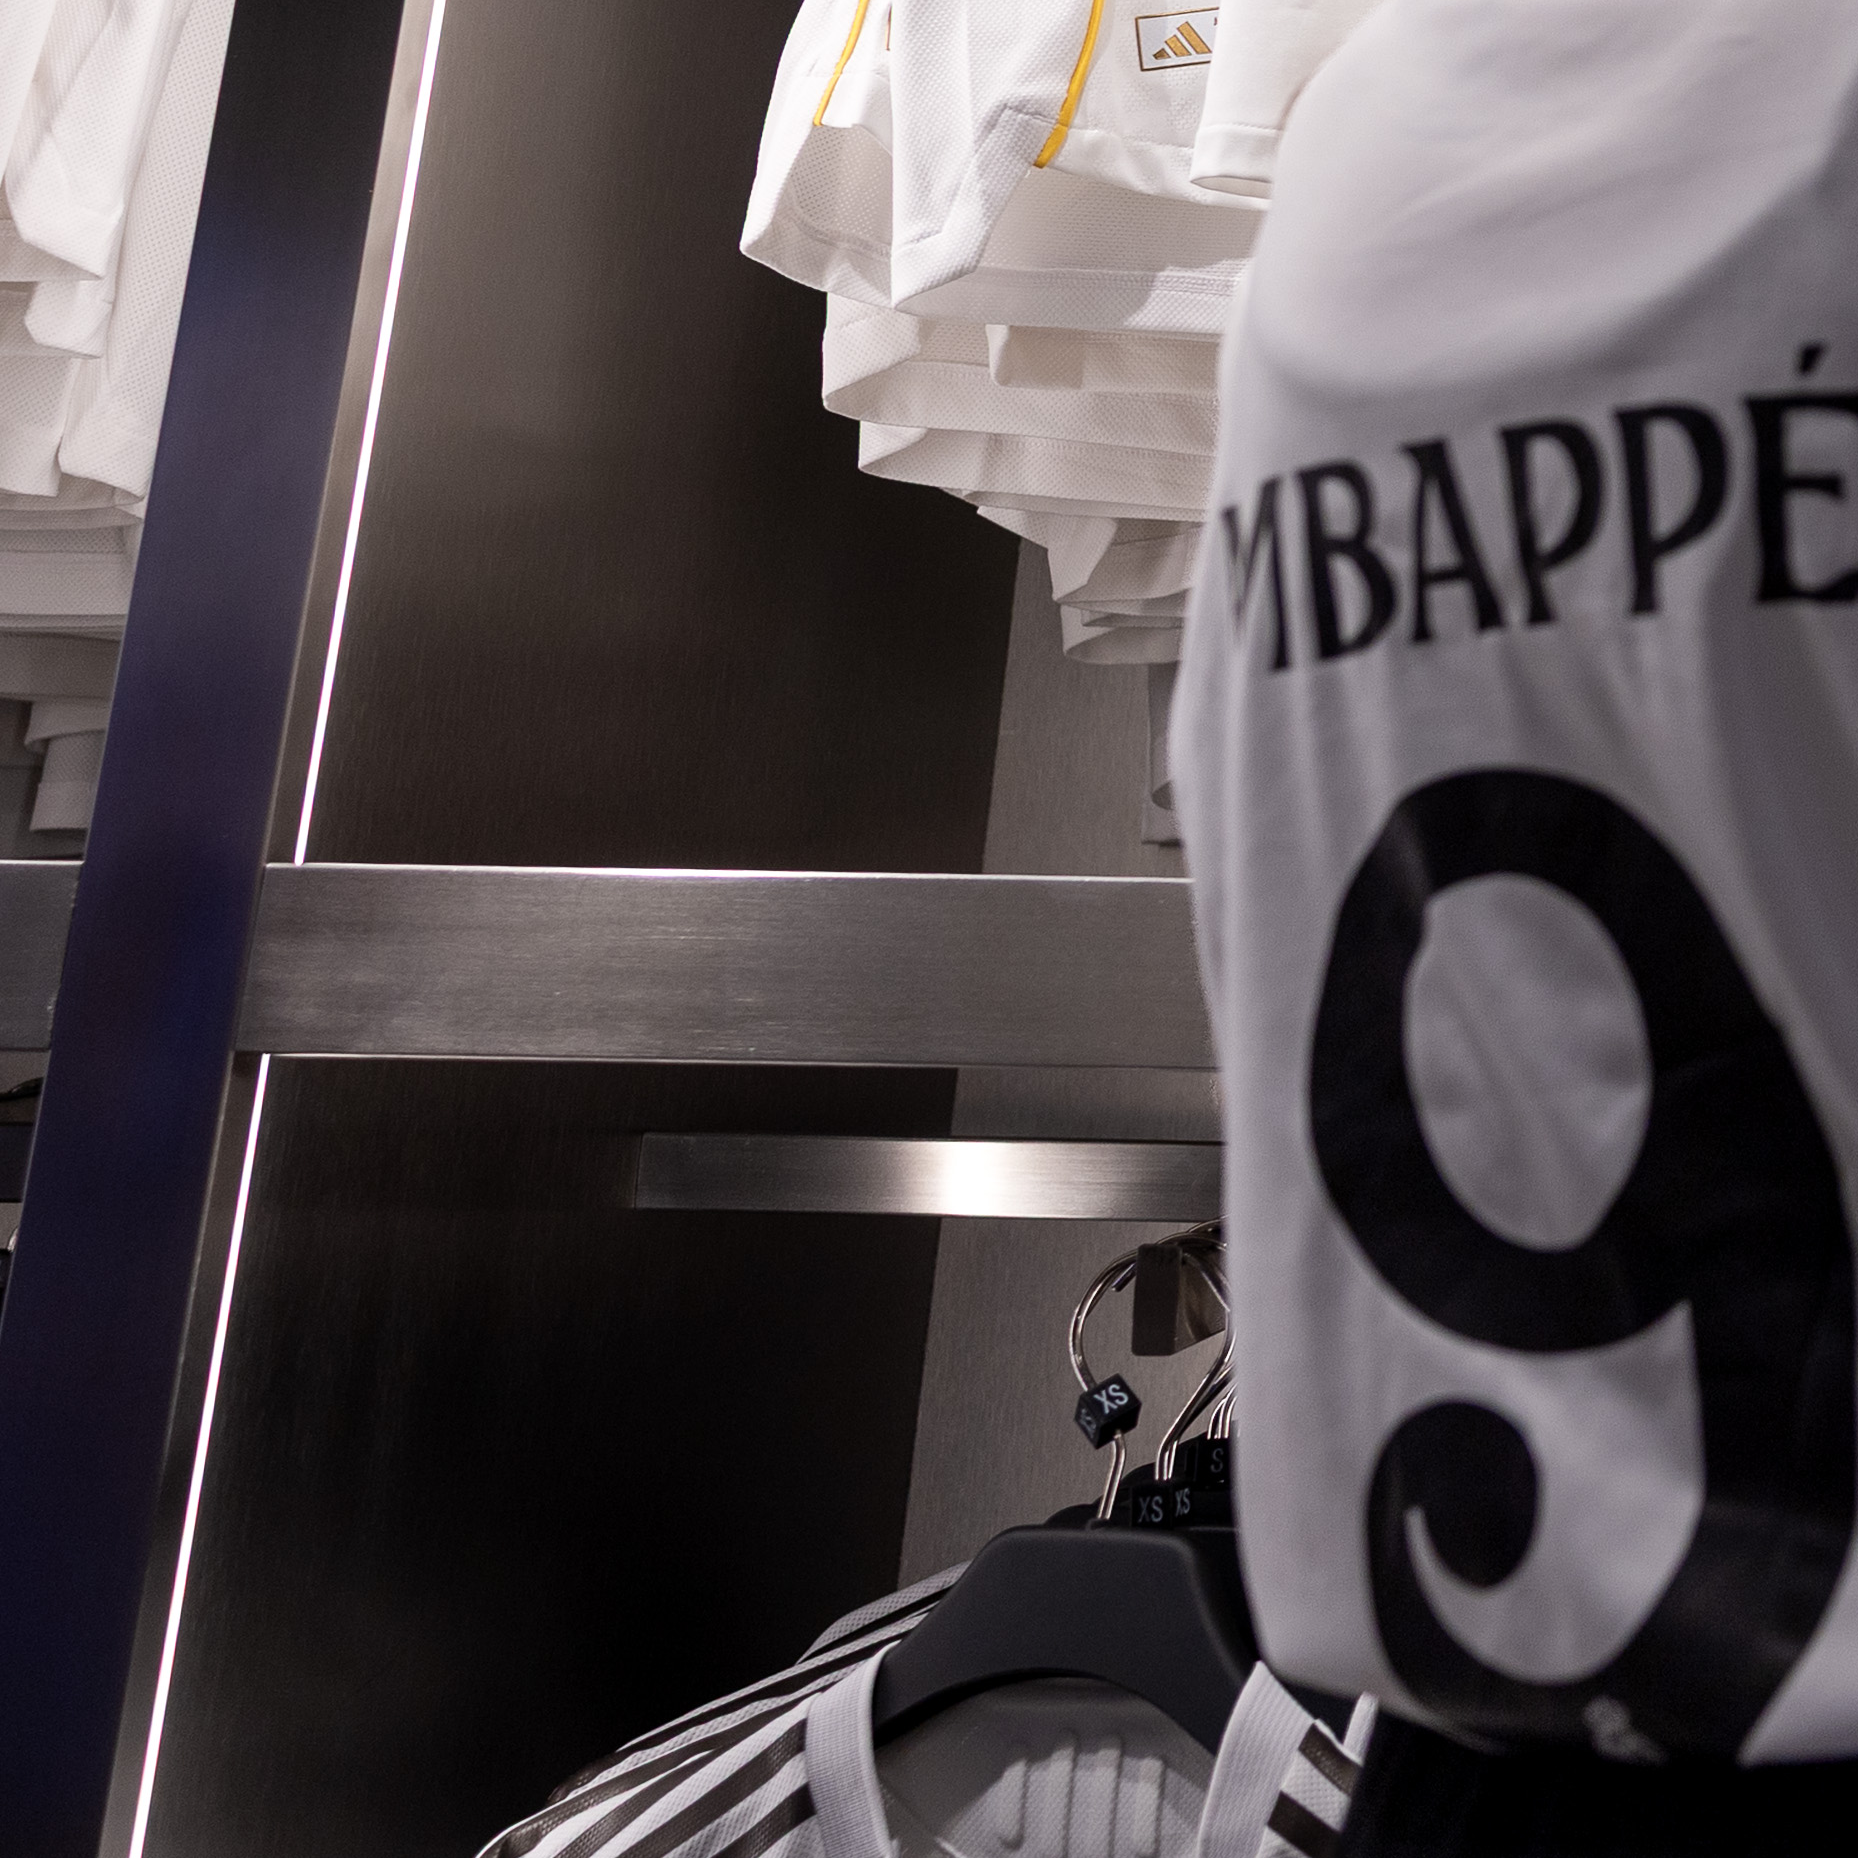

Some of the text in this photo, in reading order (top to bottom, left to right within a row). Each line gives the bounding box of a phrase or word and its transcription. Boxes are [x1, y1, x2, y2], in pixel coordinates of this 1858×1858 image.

[1093, 1382, 1130, 1415] XS
[1209, 1447, 1225, 1474] S
[1137, 1494, 1165, 1524] XS
[1174, 1487, 1192, 1518] XS
